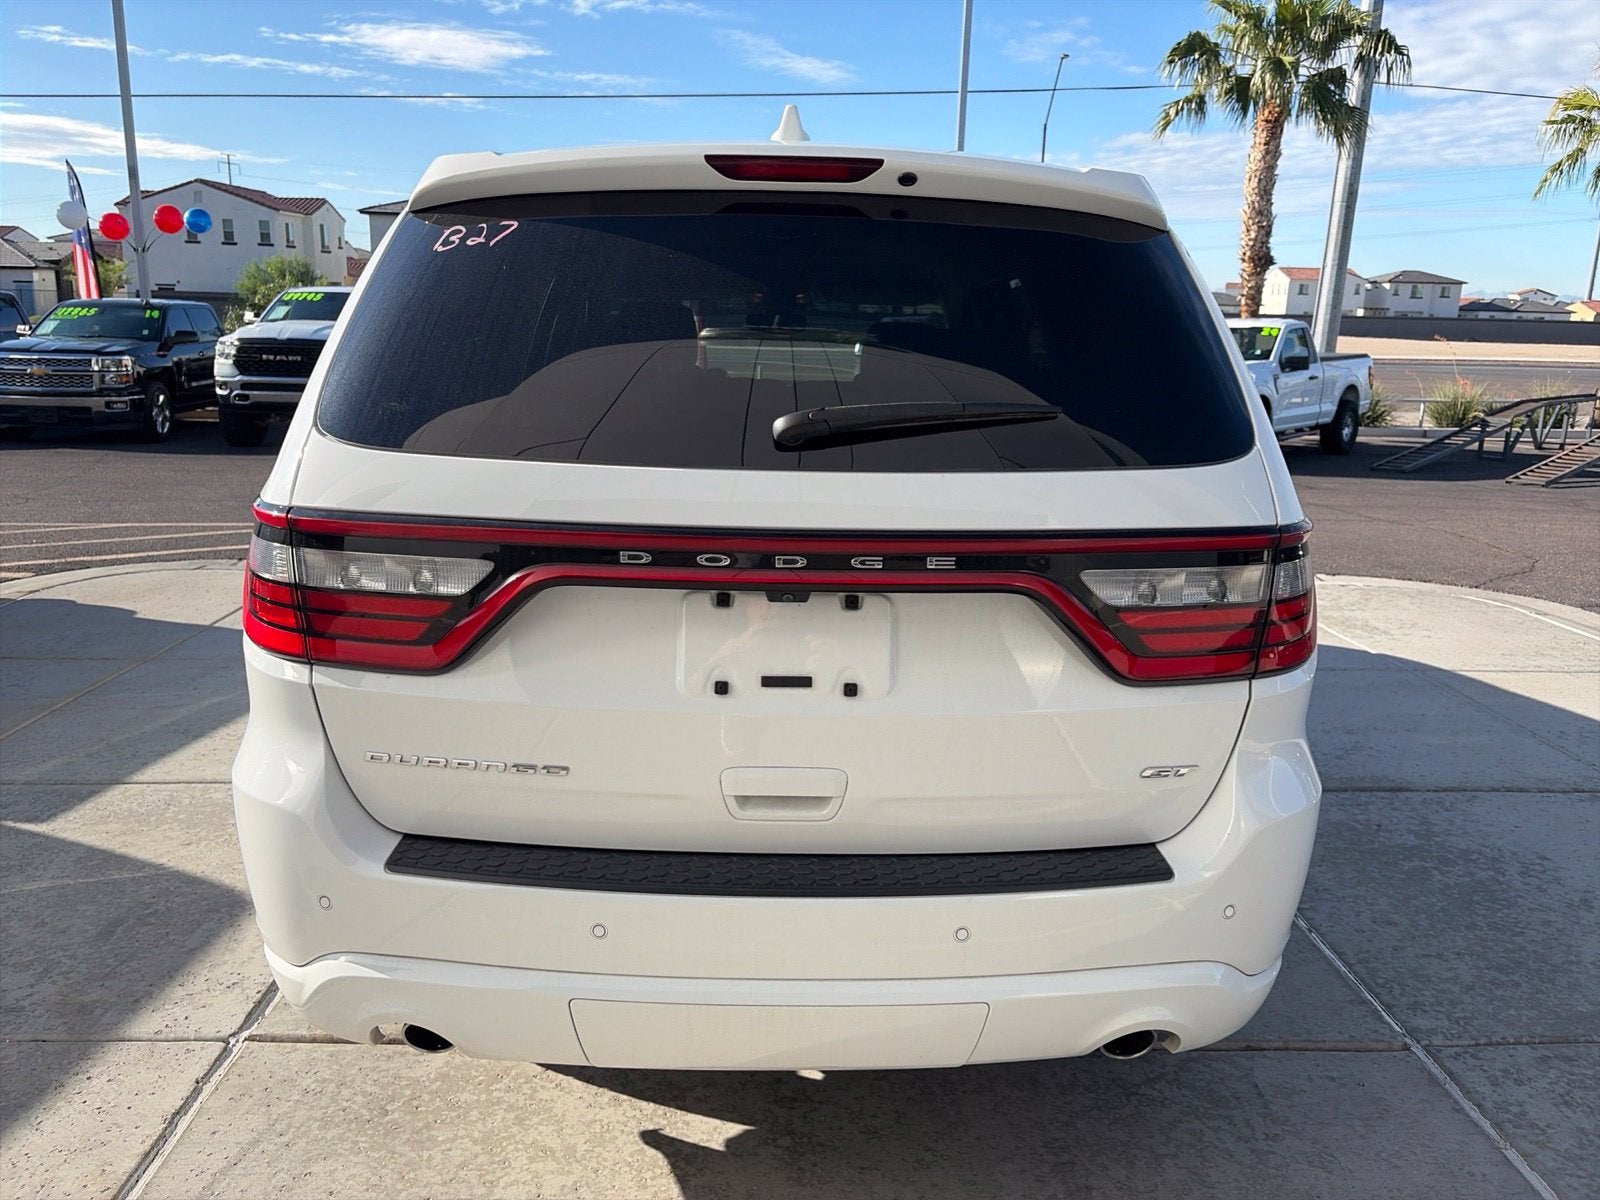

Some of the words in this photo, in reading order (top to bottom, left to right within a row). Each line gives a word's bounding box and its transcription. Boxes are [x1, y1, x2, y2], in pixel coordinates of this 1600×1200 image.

[433, 220, 519, 252] B27
[619, 550, 957, 569] DODGE
[364, 751, 571, 776] DURANGO
[1140, 764, 1199, 778] GT
